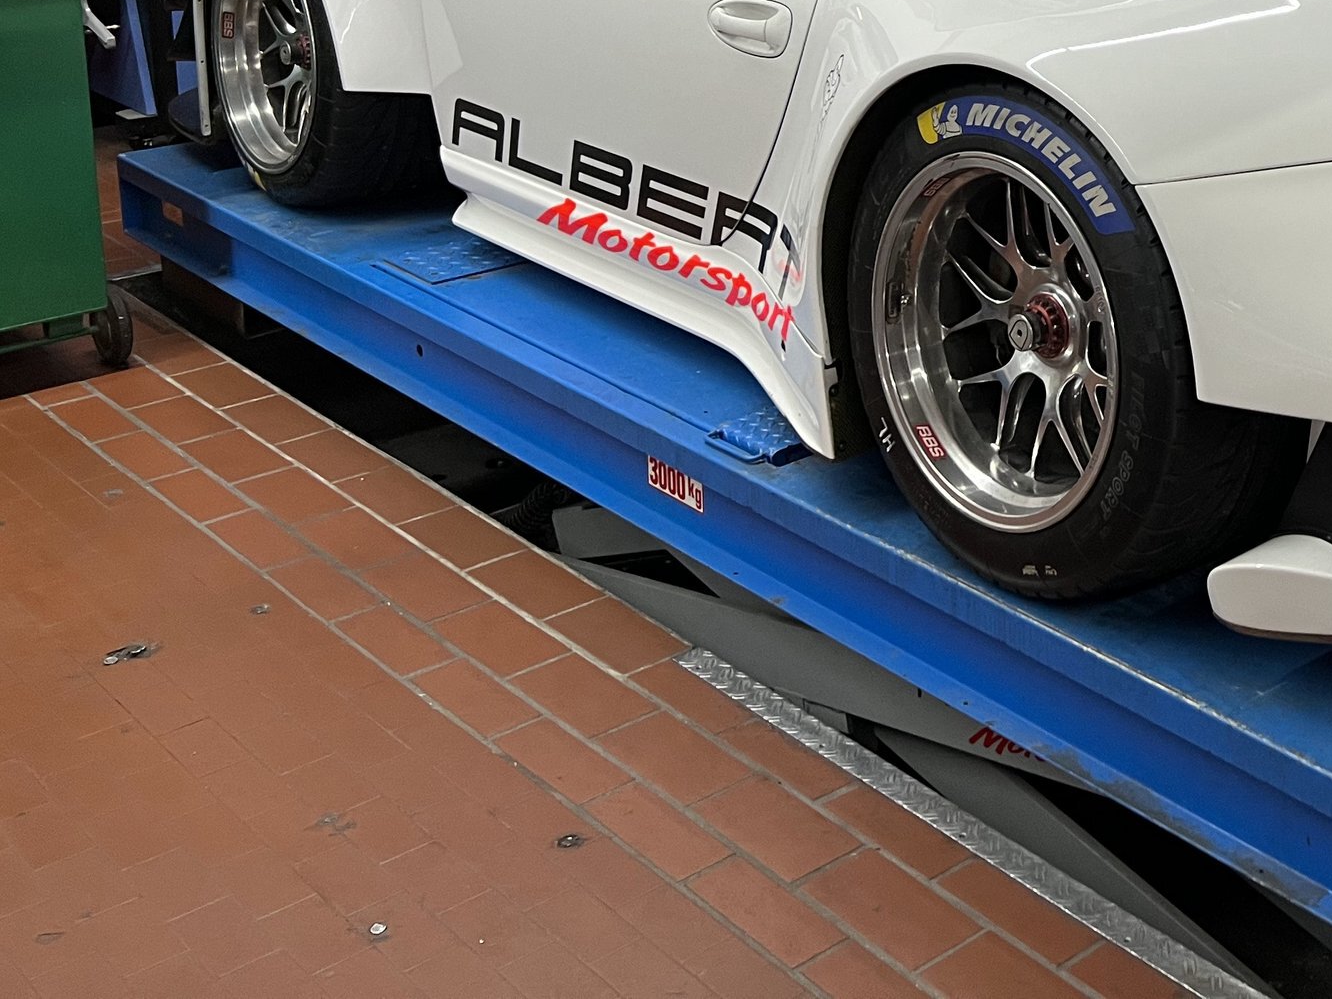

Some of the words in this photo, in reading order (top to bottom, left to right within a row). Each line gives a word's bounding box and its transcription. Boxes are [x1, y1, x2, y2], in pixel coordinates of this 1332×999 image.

[452, 98, 801, 300] ALBERT
[965, 103, 1117, 217] MICHELIN
[536, 198, 796, 341] Motorsport
[650, 457, 685, 500] 3000
[688, 476, 702, 509] kg
[916, 426, 944, 457] BBS
